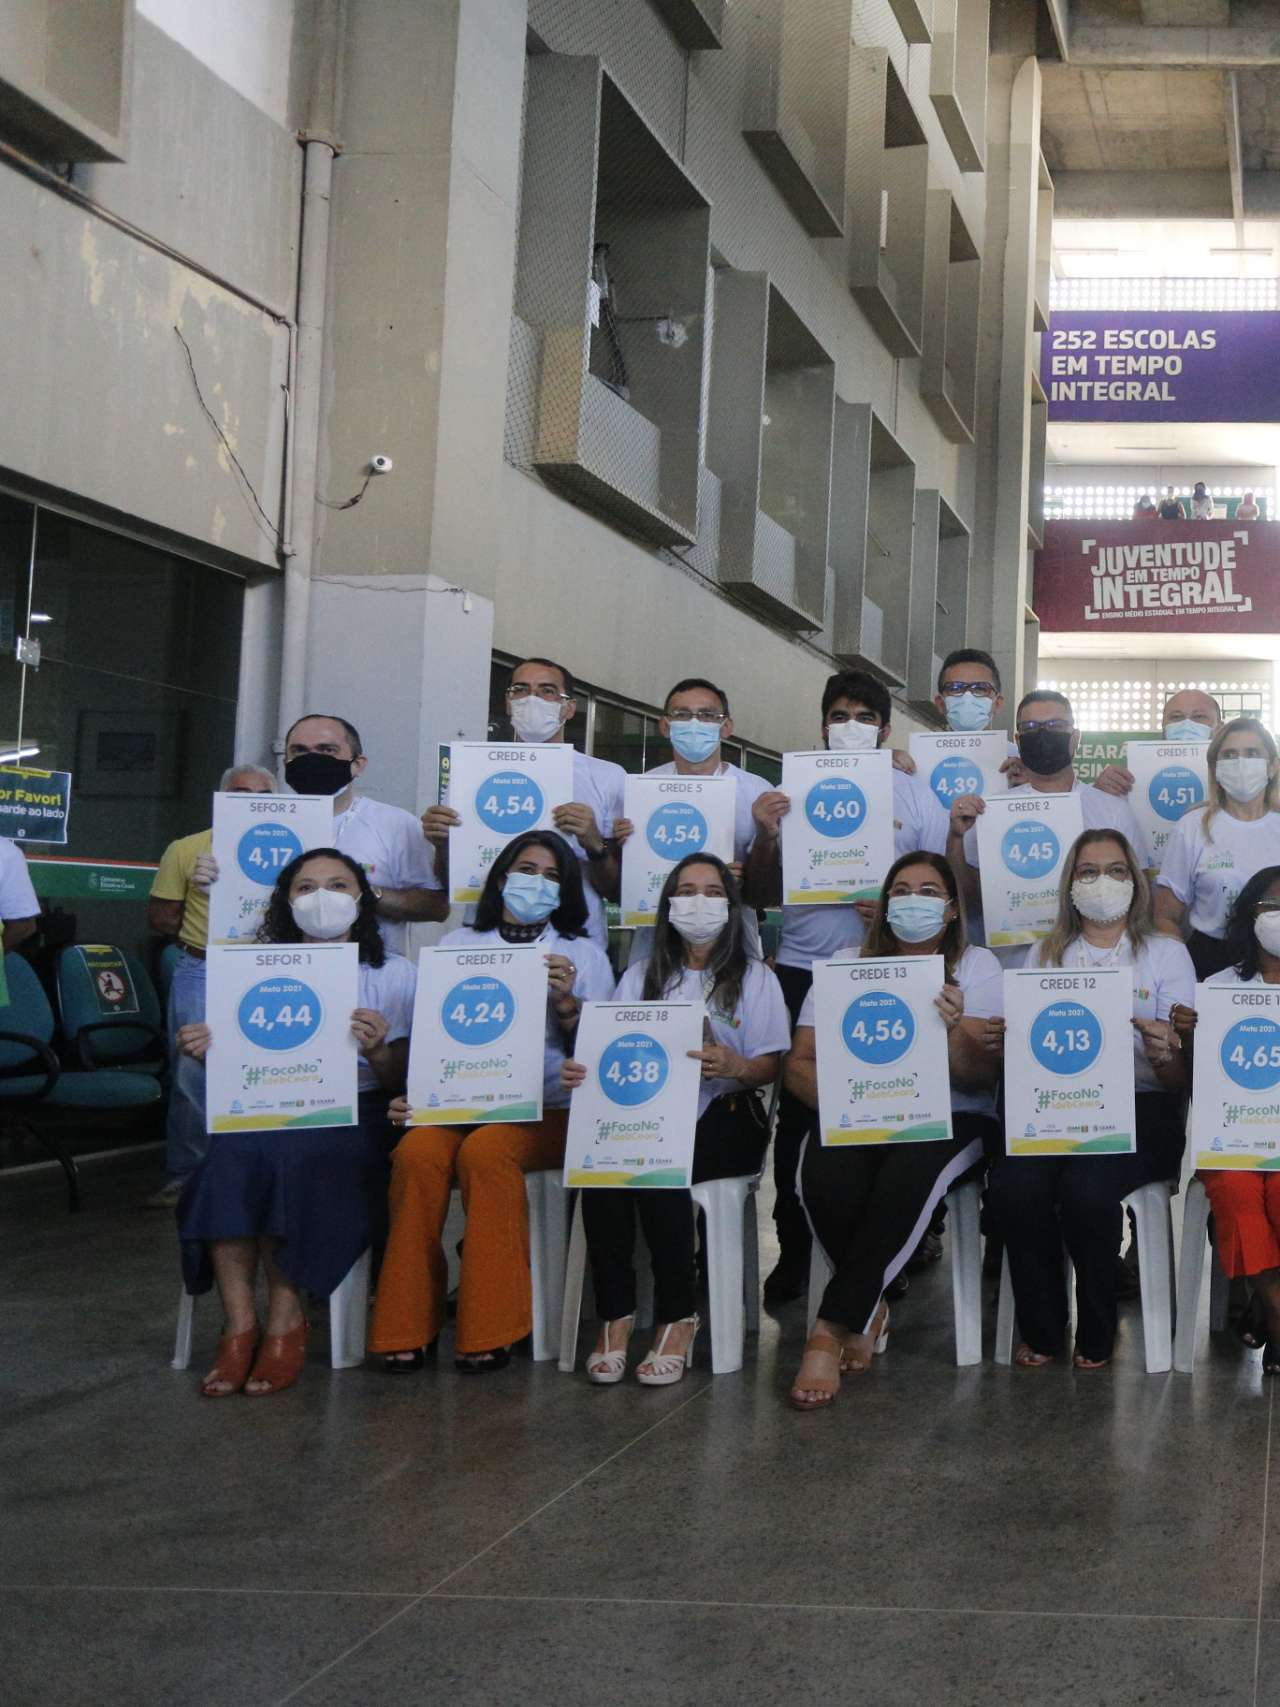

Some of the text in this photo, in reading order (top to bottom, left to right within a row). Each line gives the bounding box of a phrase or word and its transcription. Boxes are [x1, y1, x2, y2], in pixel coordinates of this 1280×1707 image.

[1052, 330, 1216, 350] 252 ESCOLAS
[1052, 356, 1182, 375] EM TEMPO
[1051, 381, 1176, 401] INTEGRAL
[1091, 540, 1236, 576] JUVENTUDE
[1126, 567, 1199, 583] EM TEMPO
[1093, 570, 1242, 609] INTEGRAL
[936, 739, 981, 748] CREDE 20
[1157, 748, 1188, 757] CREDE
[488, 751, 536, 761] CREDE 6
[816, 759, 859, 768] CREDE 7
[659, 783, 702, 792] CREDE 5
[937, 777, 977, 795] 4,39
[16, 790, 61, 805] Favor!
[484, 795, 536, 817] 4,54
[1008, 801, 1050, 812] CREDE 2
[1158, 788, 1195, 806] 4,51
[43, 808, 64, 818] lado
[251, 803, 296, 813] SEFOR 2
[813, 800, 860, 821] 4,60
[654, 825, 700, 845] 4,54
[248, 847, 293, 869] 4,17
[812, 849, 865, 866] #FocoNo
[1009, 842, 1053, 863] 4,45
[256, 954, 312, 966] SEFOR 1
[456, 954, 512, 965] CREDE 17
[851, 967, 907, 980] CREDE 13
[1040, 978, 1096, 989] CREDE 12
[1232, 994, 1272, 1005] CREDE
[248, 1005, 312, 1031] 4,44
[451, 1002, 506, 1026] 4,24
[615, 1011, 668, 1021] CREDE 18
[852, 1019, 907, 1045] 4,56
[1043, 1029, 1090, 1055] 4,13
[246, 1064, 318, 1085] #FocoNo
[443, 1058, 508, 1079] #FocoNo
[606, 1061, 660, 1086] 4,38
[852, 1077, 914, 1099] #FocoNo
[1038, 1088, 1100, 1109] #FocoNo
[598, 1120, 659, 1141] #FocoNo
